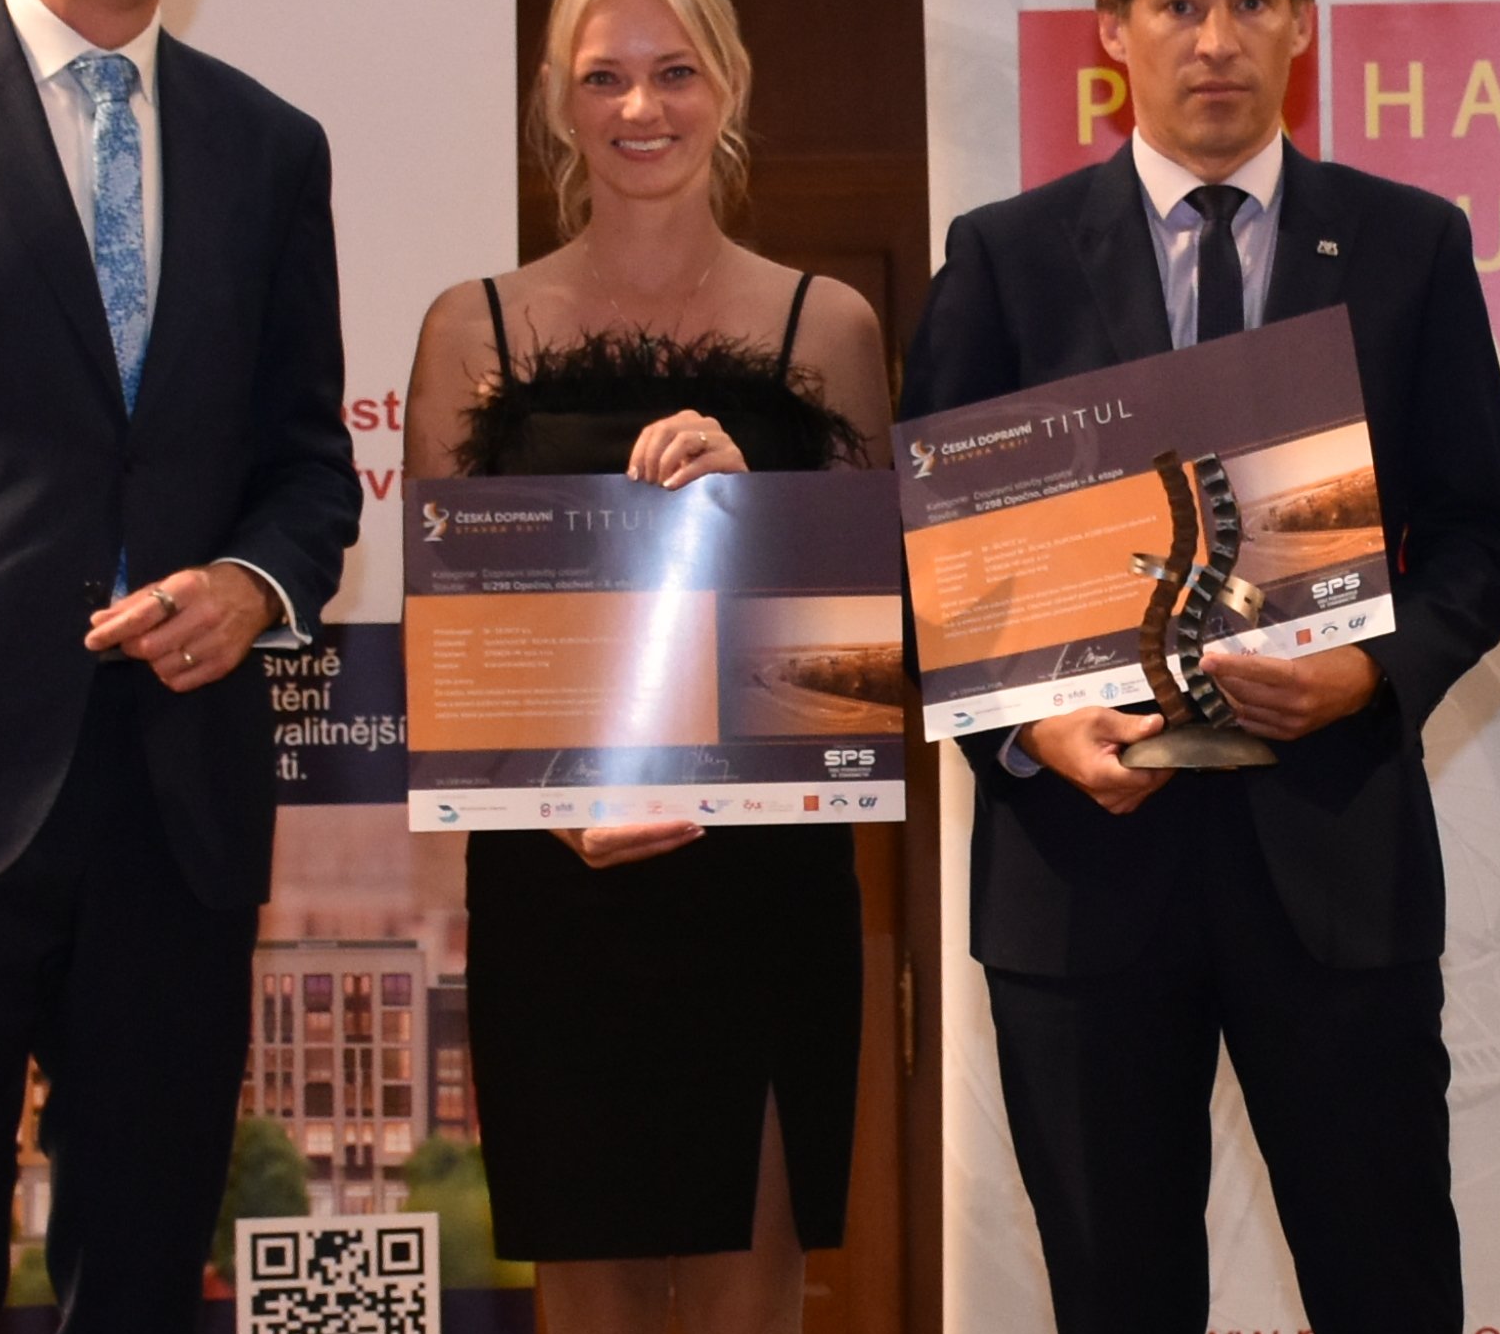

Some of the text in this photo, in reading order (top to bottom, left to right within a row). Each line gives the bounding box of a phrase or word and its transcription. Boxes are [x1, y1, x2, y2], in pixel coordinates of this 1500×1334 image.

[1041, 399, 1133, 438] TITUL
[1311, 572, 1361, 600] SPS
[823, 749, 876, 767] SPS
